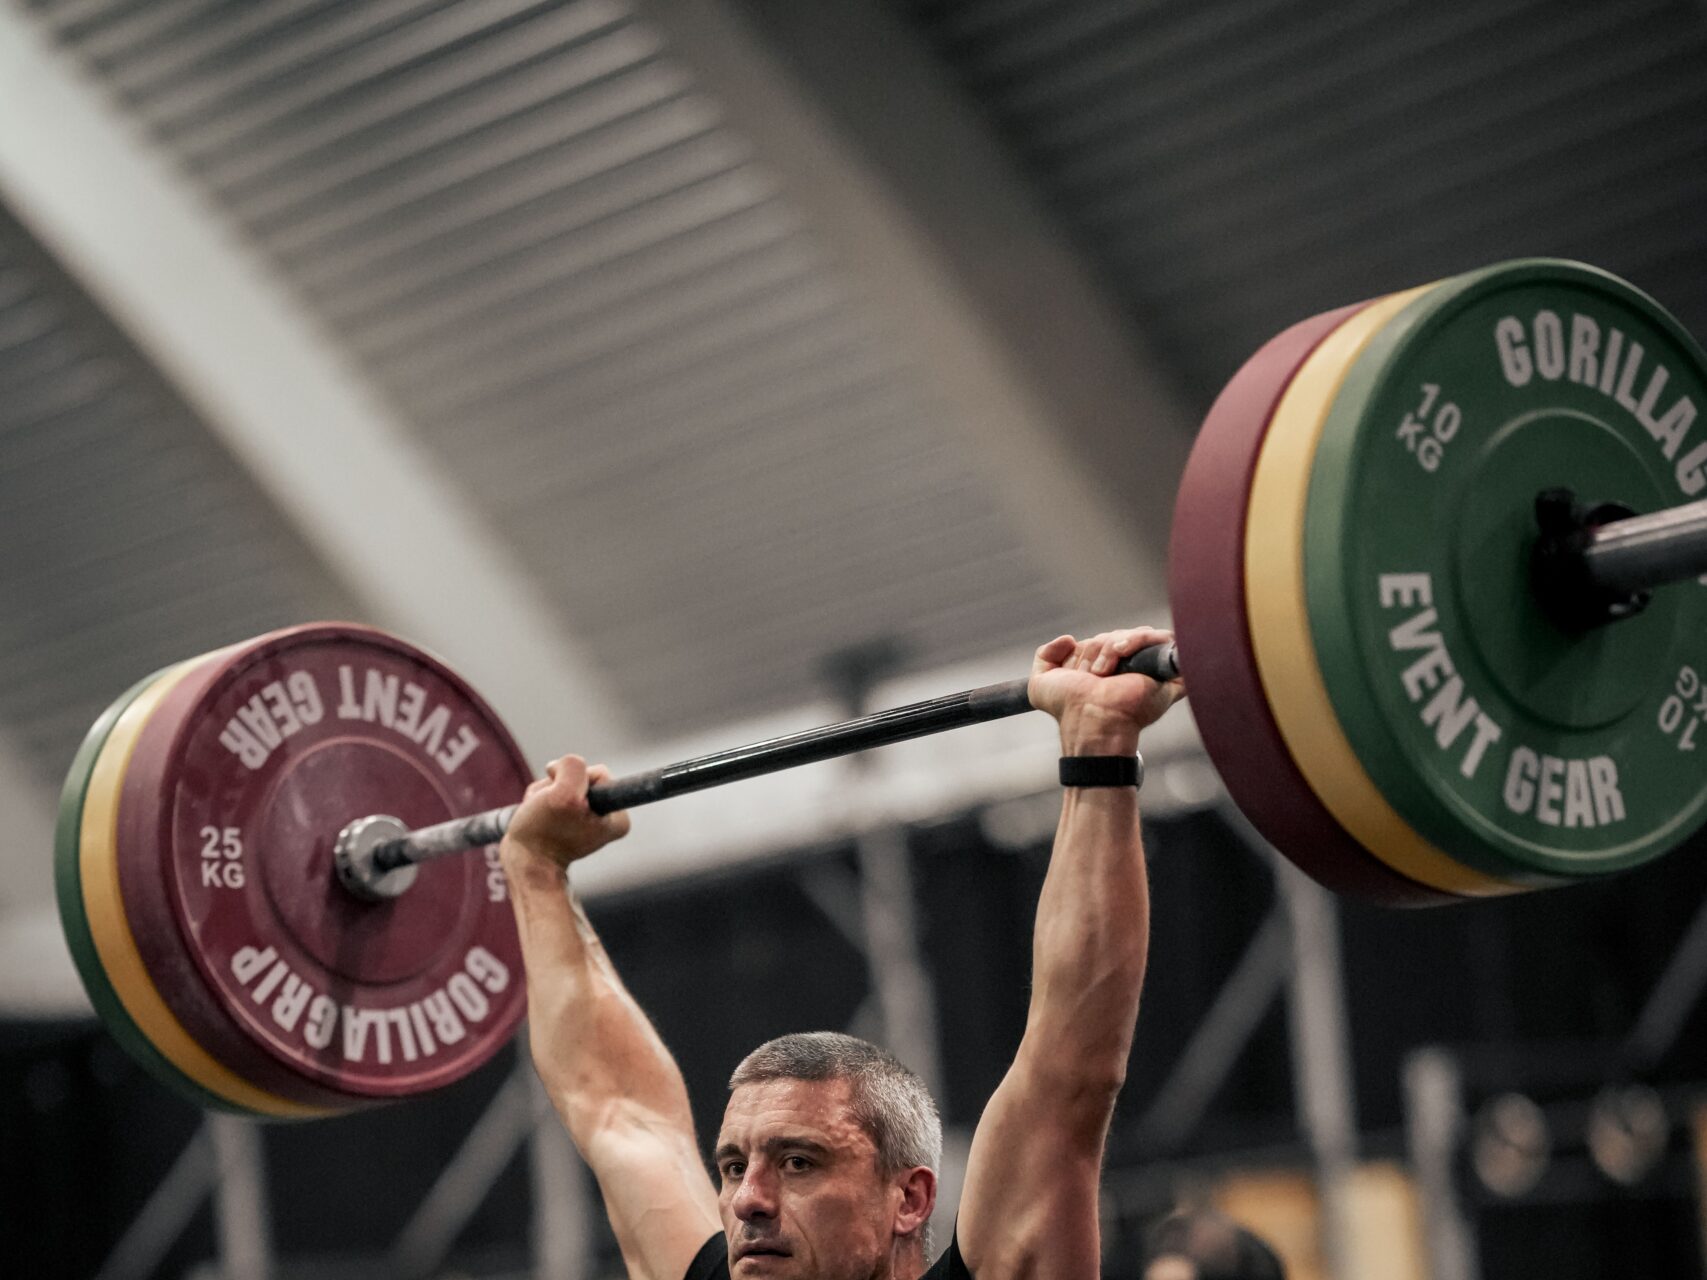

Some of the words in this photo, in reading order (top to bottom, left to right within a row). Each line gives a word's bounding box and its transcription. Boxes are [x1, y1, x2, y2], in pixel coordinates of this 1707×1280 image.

[1395, 412, 1443, 472] KG
[1418, 383, 1462, 443] 10
[1495, 309, 1707, 496] GORILLAG
[218, 670, 324, 771] GEAR
[337, 665, 480, 774] EVENT
[1378, 572, 1502, 778] EVENT
[1503, 746, 1627, 829] GEAR
[200, 825, 242, 860] 25
[201, 860, 245, 889] KG
[231, 945, 510, 1064] GORILLAGRIP
